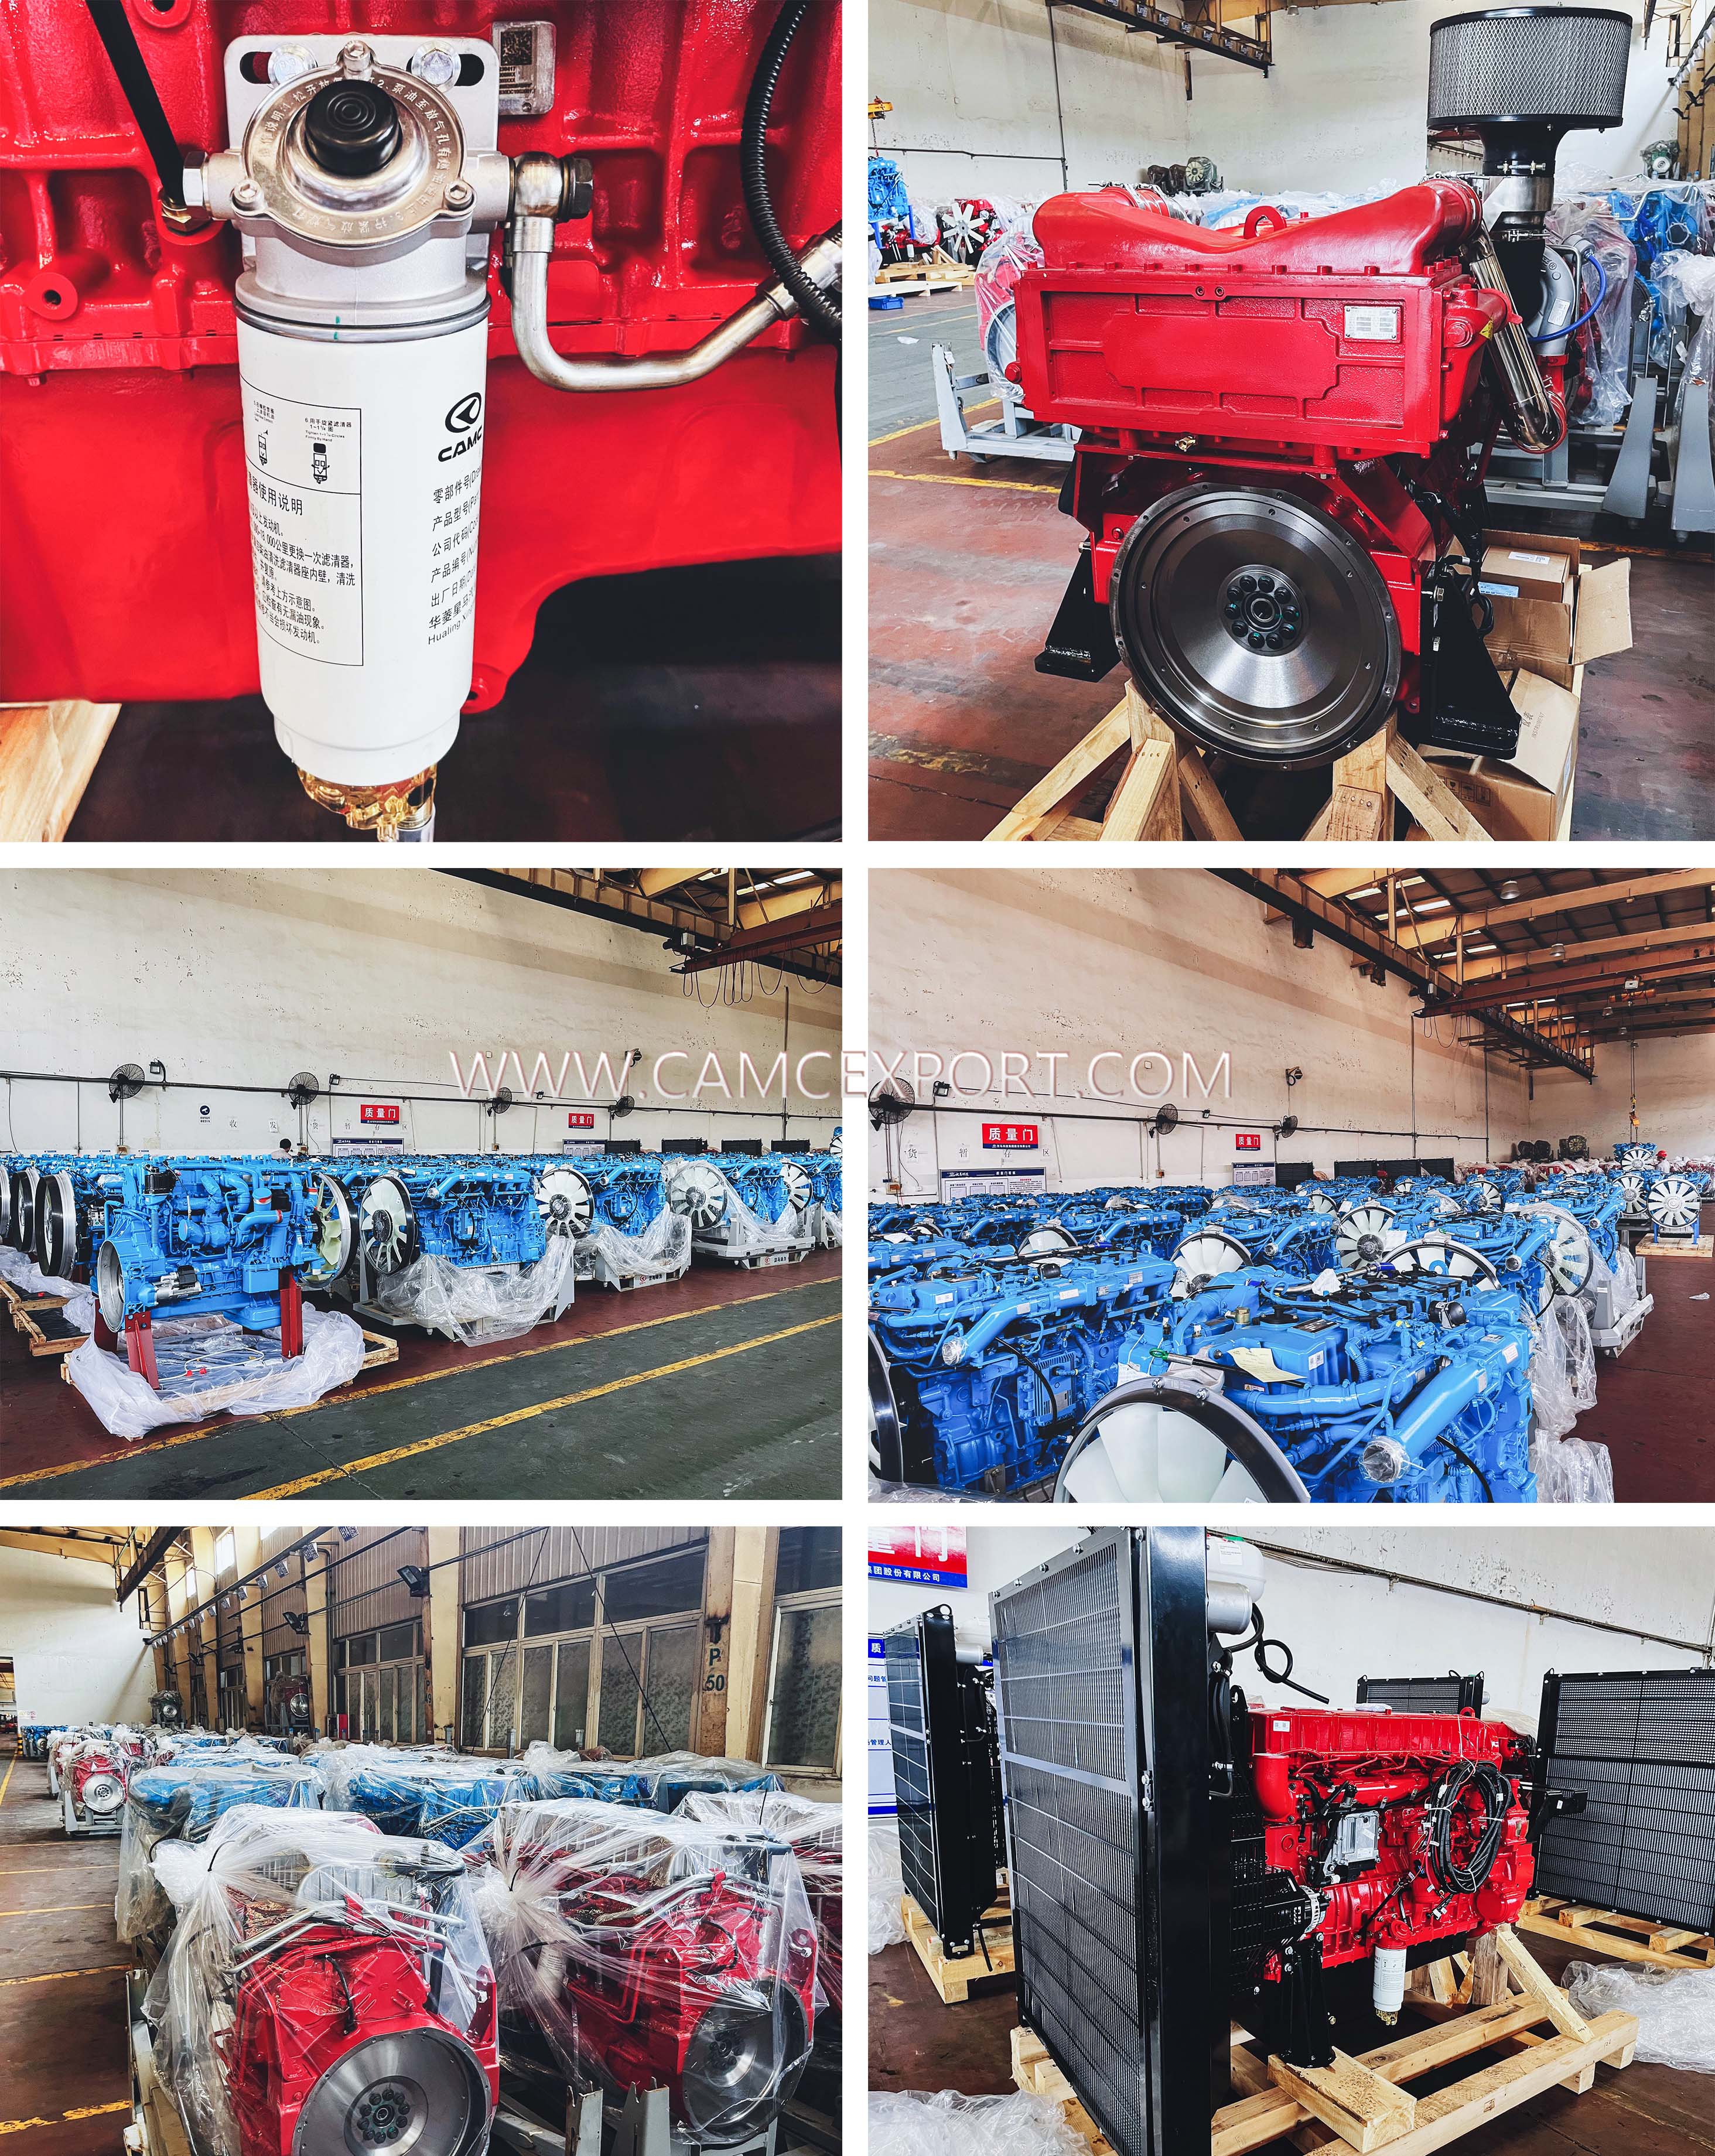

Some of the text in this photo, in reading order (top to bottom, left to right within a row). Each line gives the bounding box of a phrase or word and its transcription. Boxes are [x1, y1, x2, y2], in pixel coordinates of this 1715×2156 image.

[428, 620, 460, 645] Hualing
[1531, 712, 1545, 740] INSTRUMENT
[364, 1108, 396, 1119] 质量门
[571, 1115, 592, 1124] 质量门
[989, 1127, 1034, 1142] 质量门
[1238, 1136, 1259, 1146] 质量门
[870, 1642, 882, 1653] 质
[709, 1648, 721, 1666] P
[705, 1673, 725, 1692] 50
